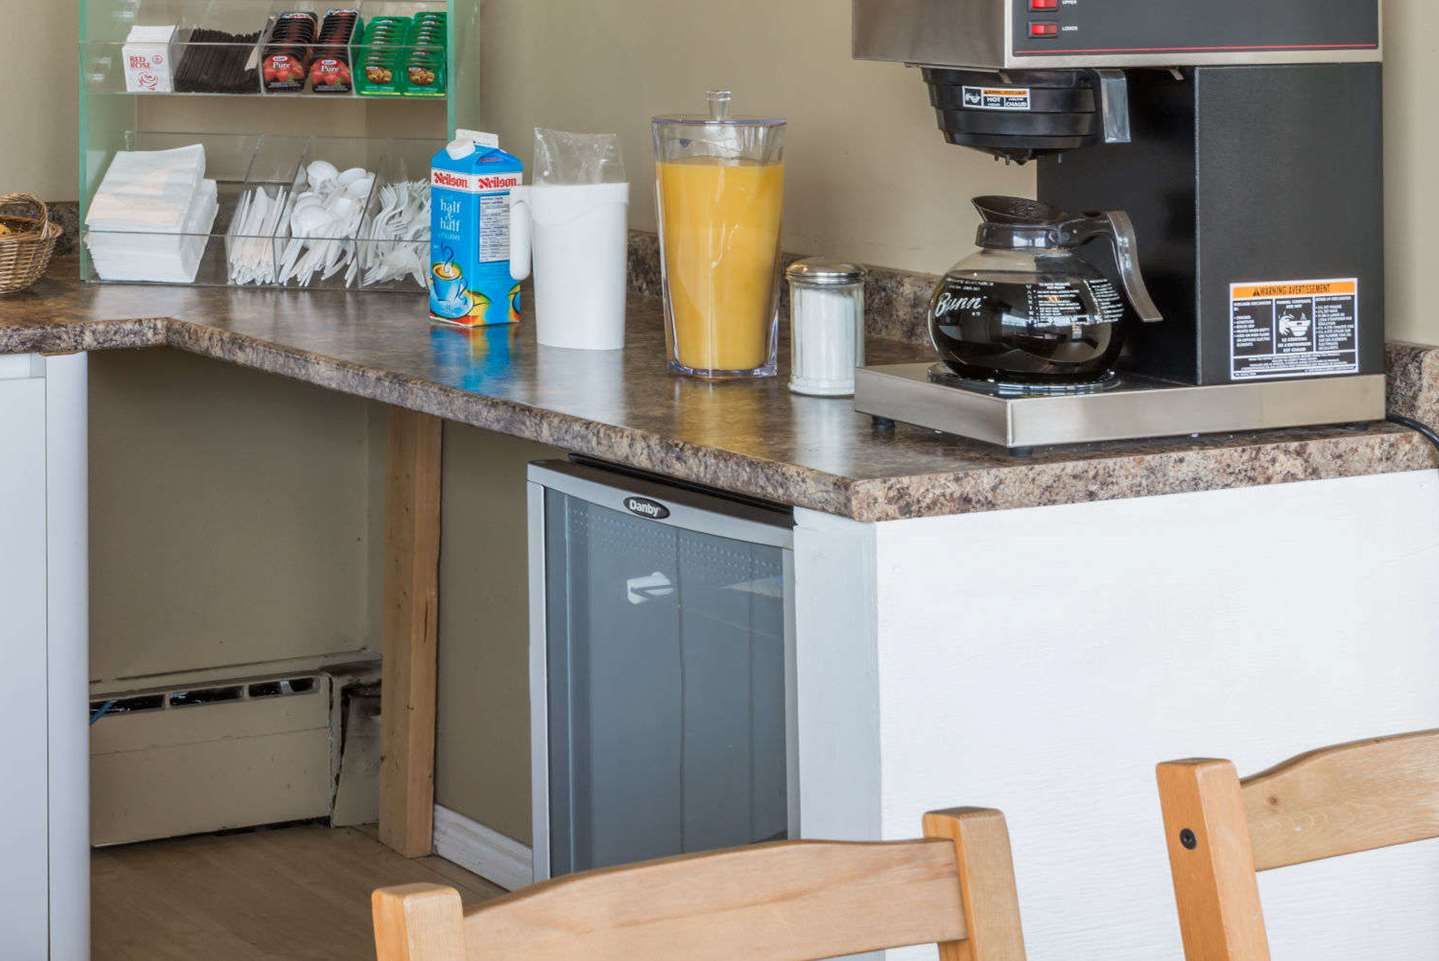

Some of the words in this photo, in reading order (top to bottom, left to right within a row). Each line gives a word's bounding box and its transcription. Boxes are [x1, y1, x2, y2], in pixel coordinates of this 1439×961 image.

[129, 55, 146, 63] RED
[272, 61, 291, 70] Pure
[321, 65, 339, 73] Pure
[433, 171, 468, 189] Neilson
[478, 176, 517, 189] Neilson
[440, 198, 462, 214] half
[440, 217, 460, 232] half
[935, 292, 982, 317] Bunn
[629, 499, 659, 517] Danby
